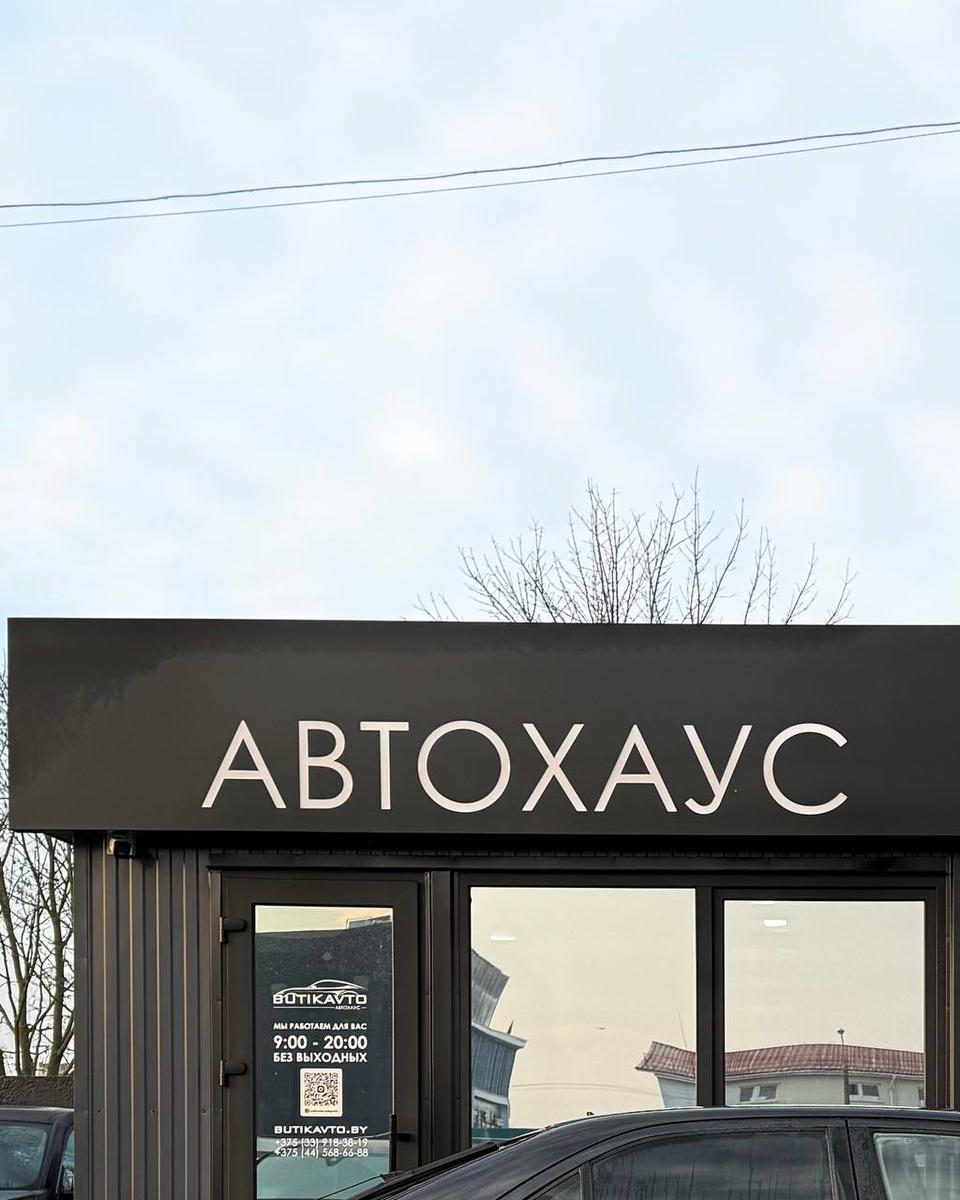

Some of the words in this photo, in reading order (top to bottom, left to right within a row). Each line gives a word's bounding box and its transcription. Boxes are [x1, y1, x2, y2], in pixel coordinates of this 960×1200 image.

[201, 719, 848, 815] АВТОХАУС
[273, 993, 367, 1005] BUTIKAVTO
[332, 1023, 349, 1031] ДЛЯ
[273, 1035, 308, 1049] 9:00
[323, 1035, 368, 1049] 20:00
[273, 1052, 293, 1062] БЕЗ
[296, 1052, 368, 1063] ВЫХОДНЫХ
[274, 1125, 368, 1134] BUTIKAVTO.BY
[274, 1138, 298, 1147] +375
[301, 1138, 319, 1148] (33)
[322, 1138, 369, 1147] 918-38-19
[274, 1148, 298, 1157] +375
[301, 1148, 319, 1159] (44)
[322, 1148, 369, 1157] 568-66-88
